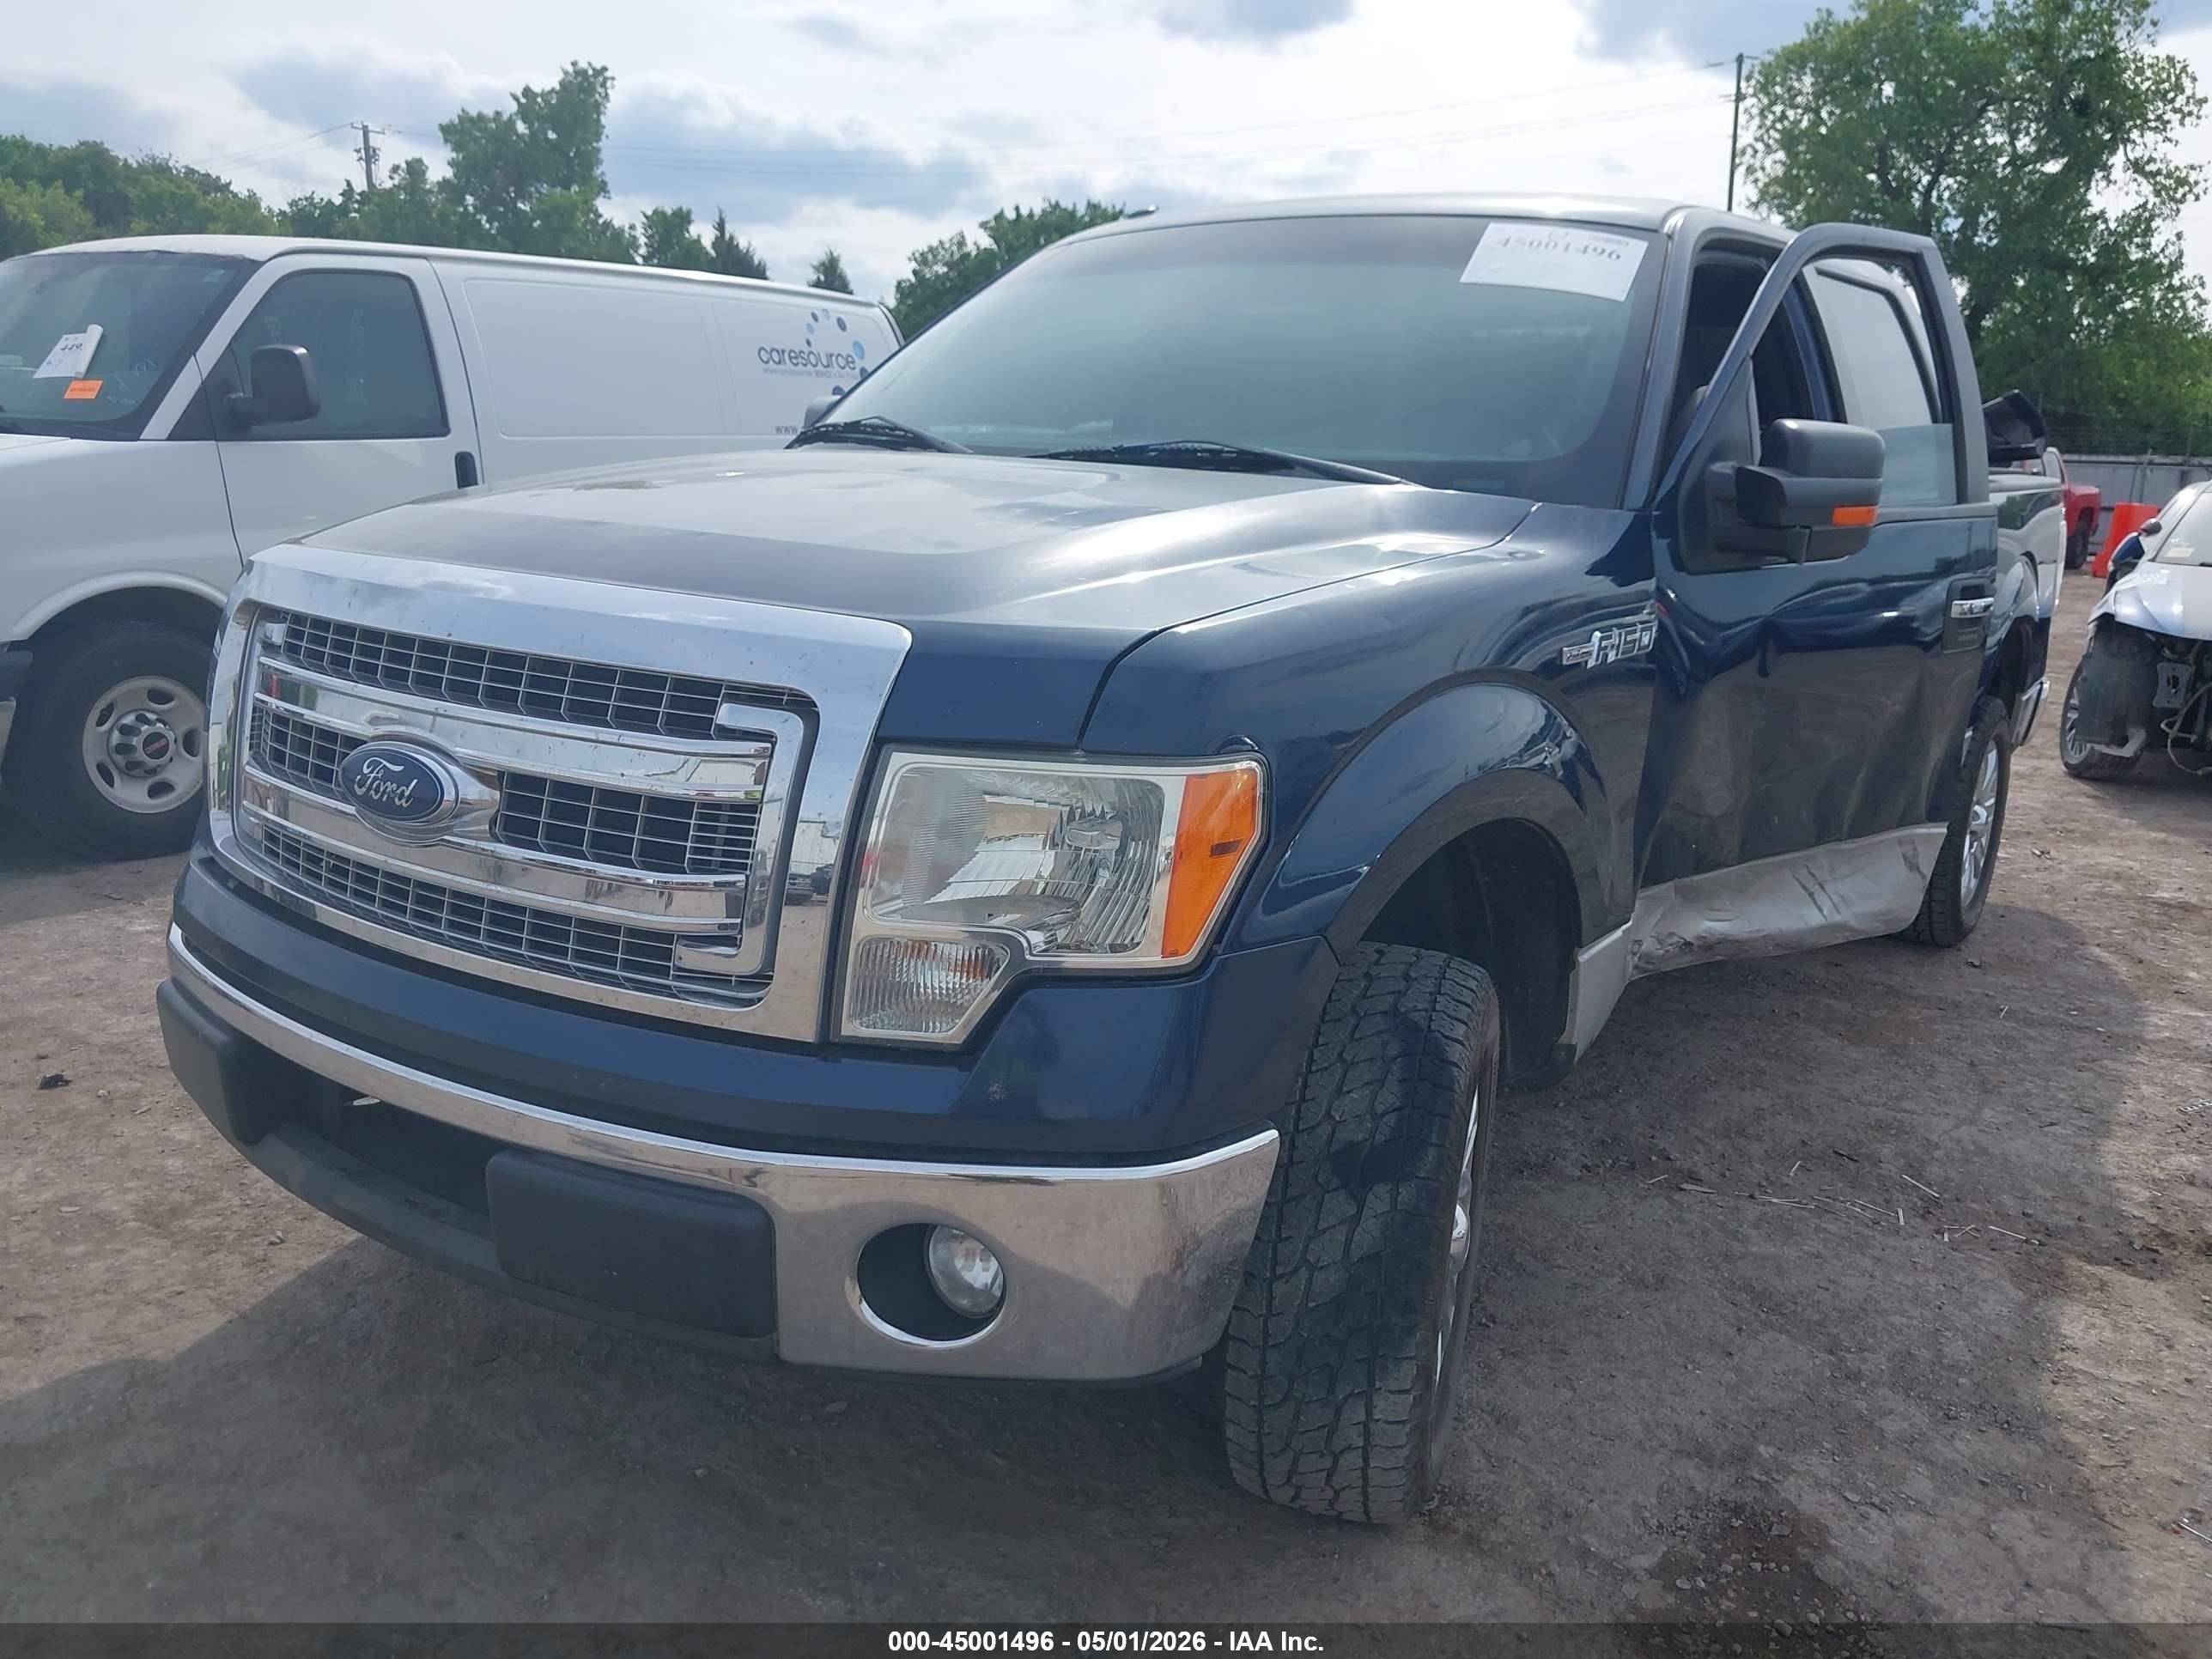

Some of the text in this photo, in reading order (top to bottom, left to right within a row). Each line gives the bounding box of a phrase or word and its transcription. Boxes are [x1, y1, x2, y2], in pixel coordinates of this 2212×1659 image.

[1498, 236, 1621, 261] 45001496
[757, 346, 856, 370] caresource
[354, 757, 419, 808] Ford
